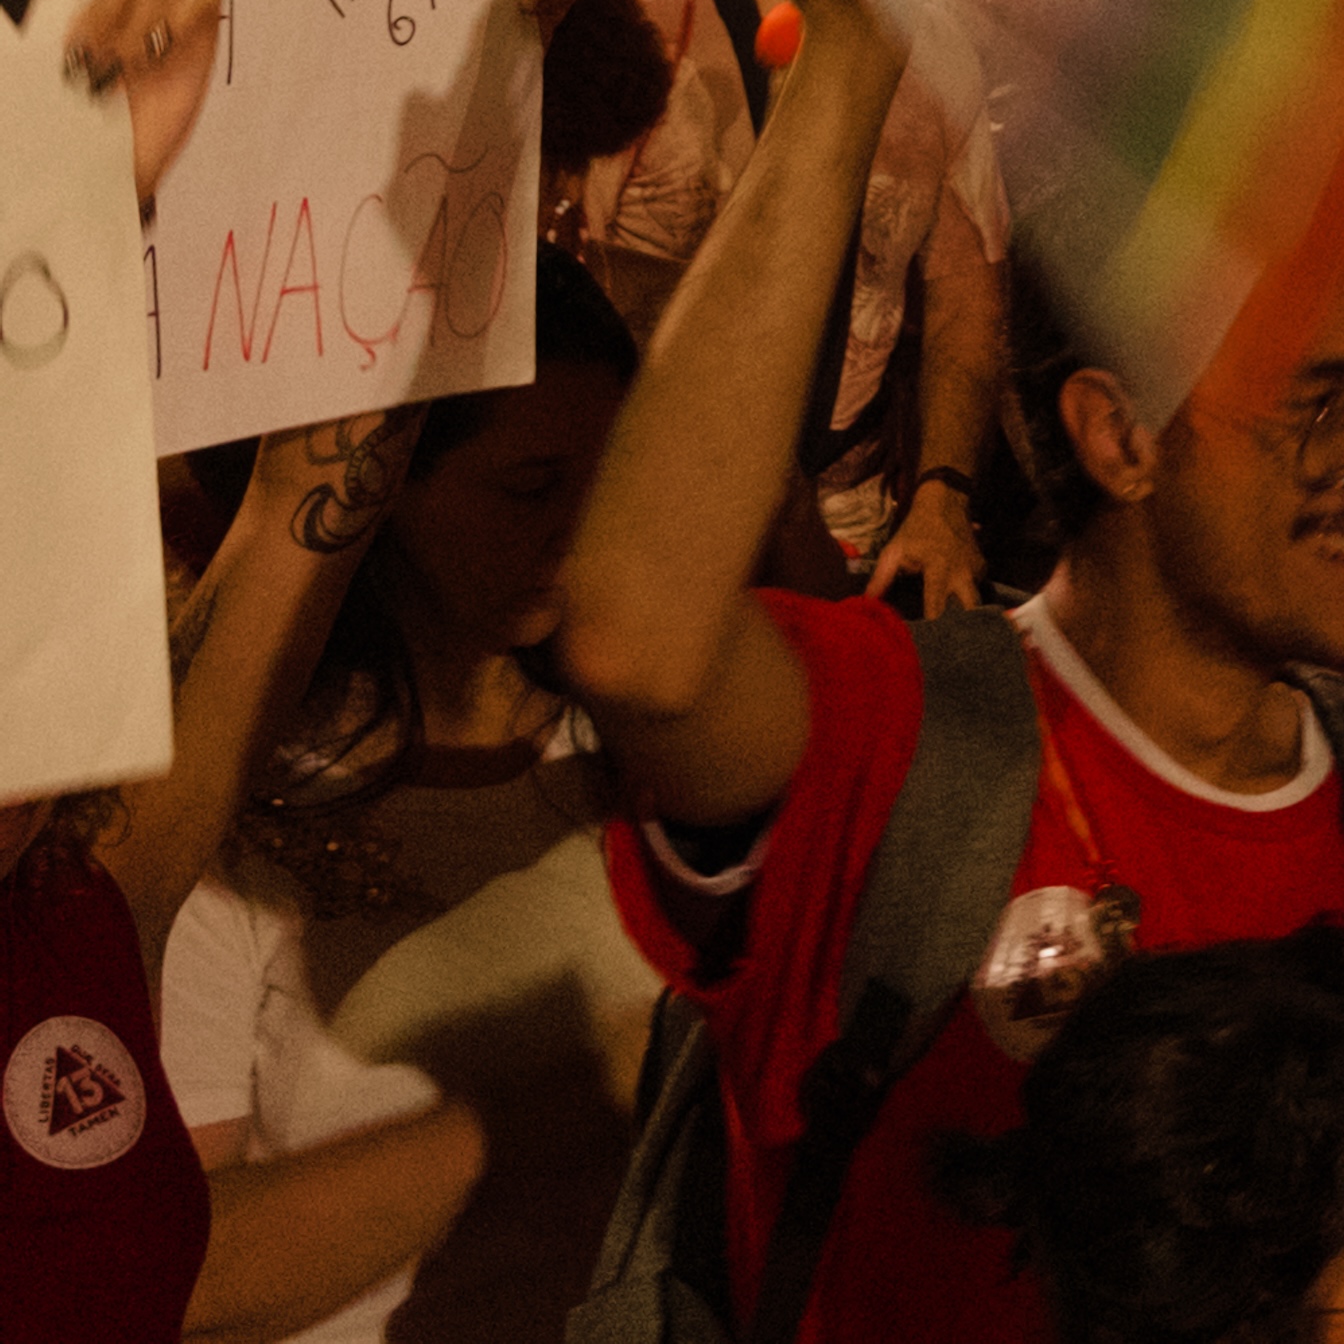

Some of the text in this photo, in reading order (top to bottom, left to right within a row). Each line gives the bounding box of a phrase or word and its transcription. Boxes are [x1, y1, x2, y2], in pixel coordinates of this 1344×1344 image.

[202, 144, 509, 373] NAÇÃO
[38, 1057, 55, 1124] LIBERTAS
[68, 1105, 121, 1138] TAMEN
